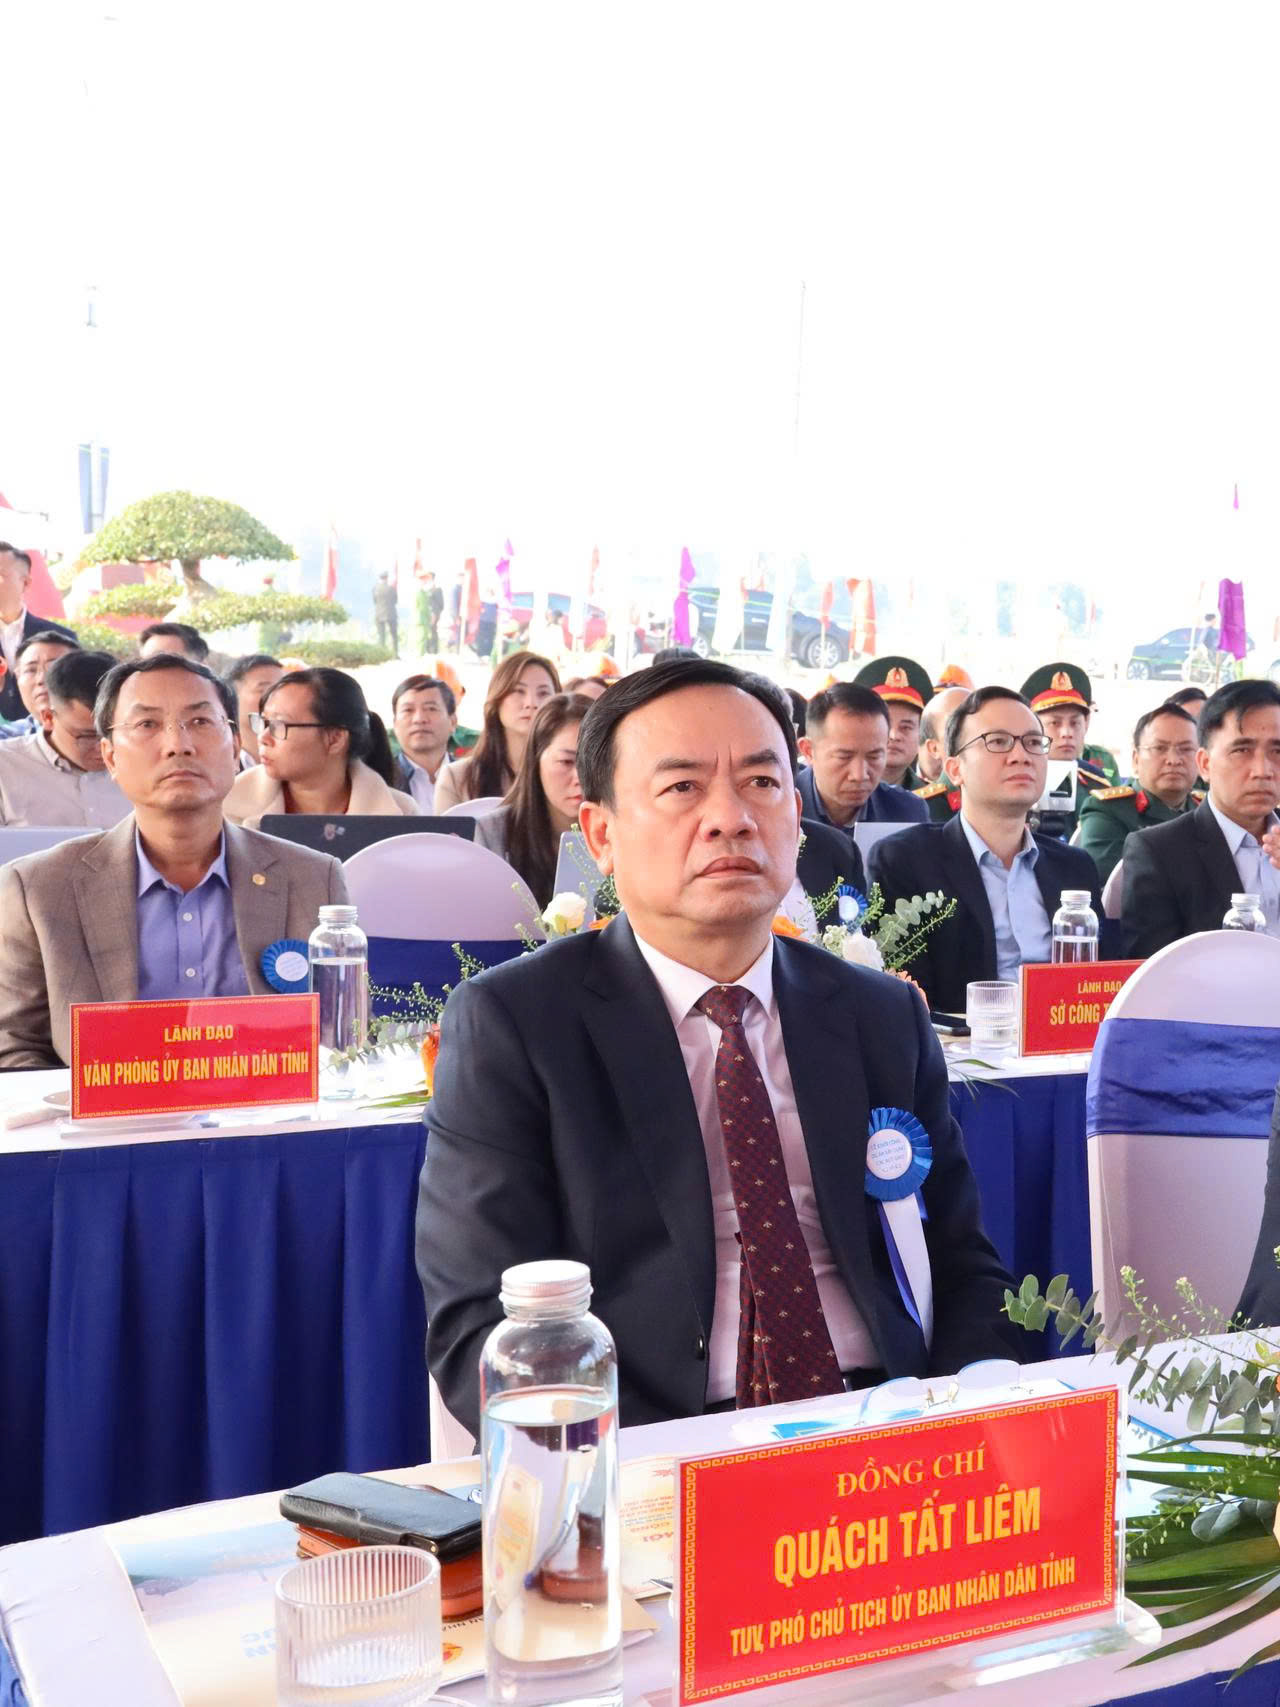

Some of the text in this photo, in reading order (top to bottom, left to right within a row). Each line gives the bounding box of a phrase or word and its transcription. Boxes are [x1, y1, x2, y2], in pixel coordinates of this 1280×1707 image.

[1077, 979, 1101, 994] LÃNH
[164, 1023, 234, 1043] LÃNH ĐẠO
[1050, 999, 1066, 1026] SỞ
[1069, 1000, 1100, 1024] CÔNG
[83, 1045, 309, 1087] VĂN PHÒNG ỦY BAN NHÂN DÂN TỈNH
[836, 1441, 986, 1497] ĐỒNG CHÍ
[774, 1482, 1041, 1587] QUÁCH TẤT LIÊM
[730, 1553, 1076, 1657] TUV, PHÓ CHỦ TỊCH ỦY BAN NHÂN DÂN TỈNH
